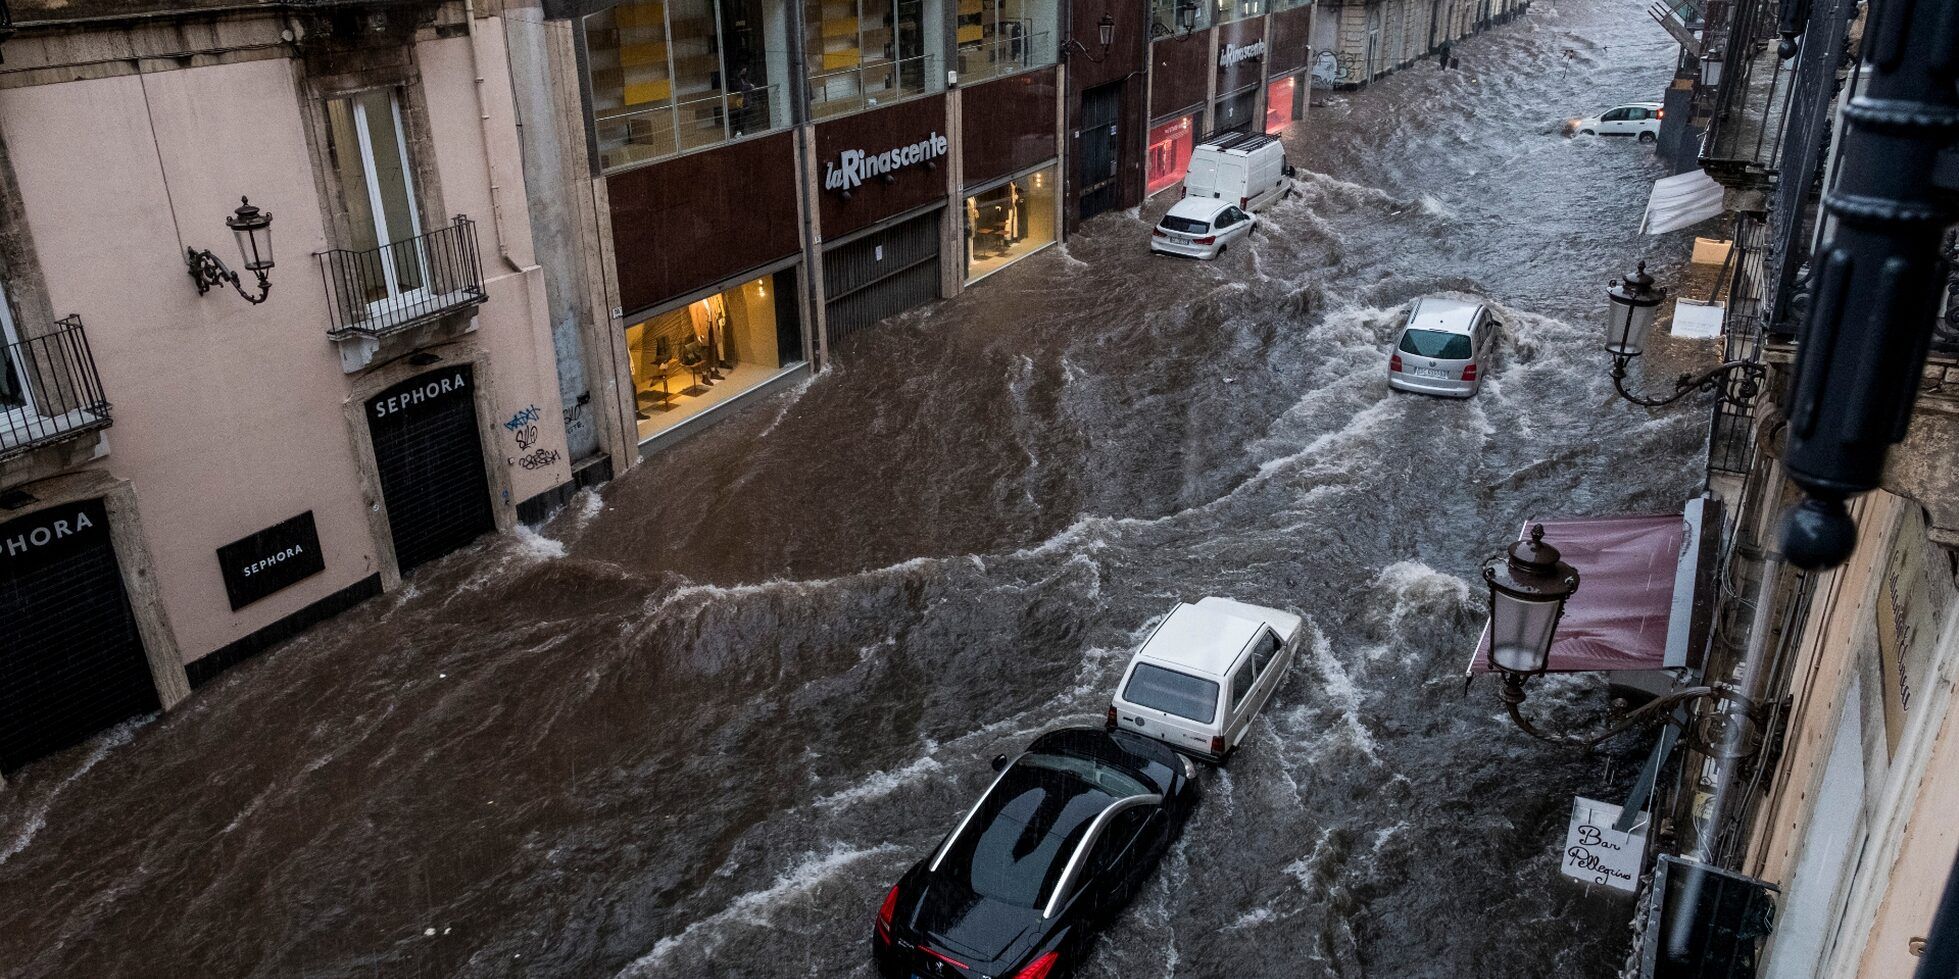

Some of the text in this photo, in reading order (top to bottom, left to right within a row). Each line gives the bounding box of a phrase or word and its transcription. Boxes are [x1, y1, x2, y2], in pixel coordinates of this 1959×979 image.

[376, 373, 465, 418] SEPHORA
[0, 511, 93, 557] HORA
[243, 544, 303, 577] SEPHORA
[1578, 825, 1621, 850] Bar
[1568, 846, 1631, 886] Pellegrino
